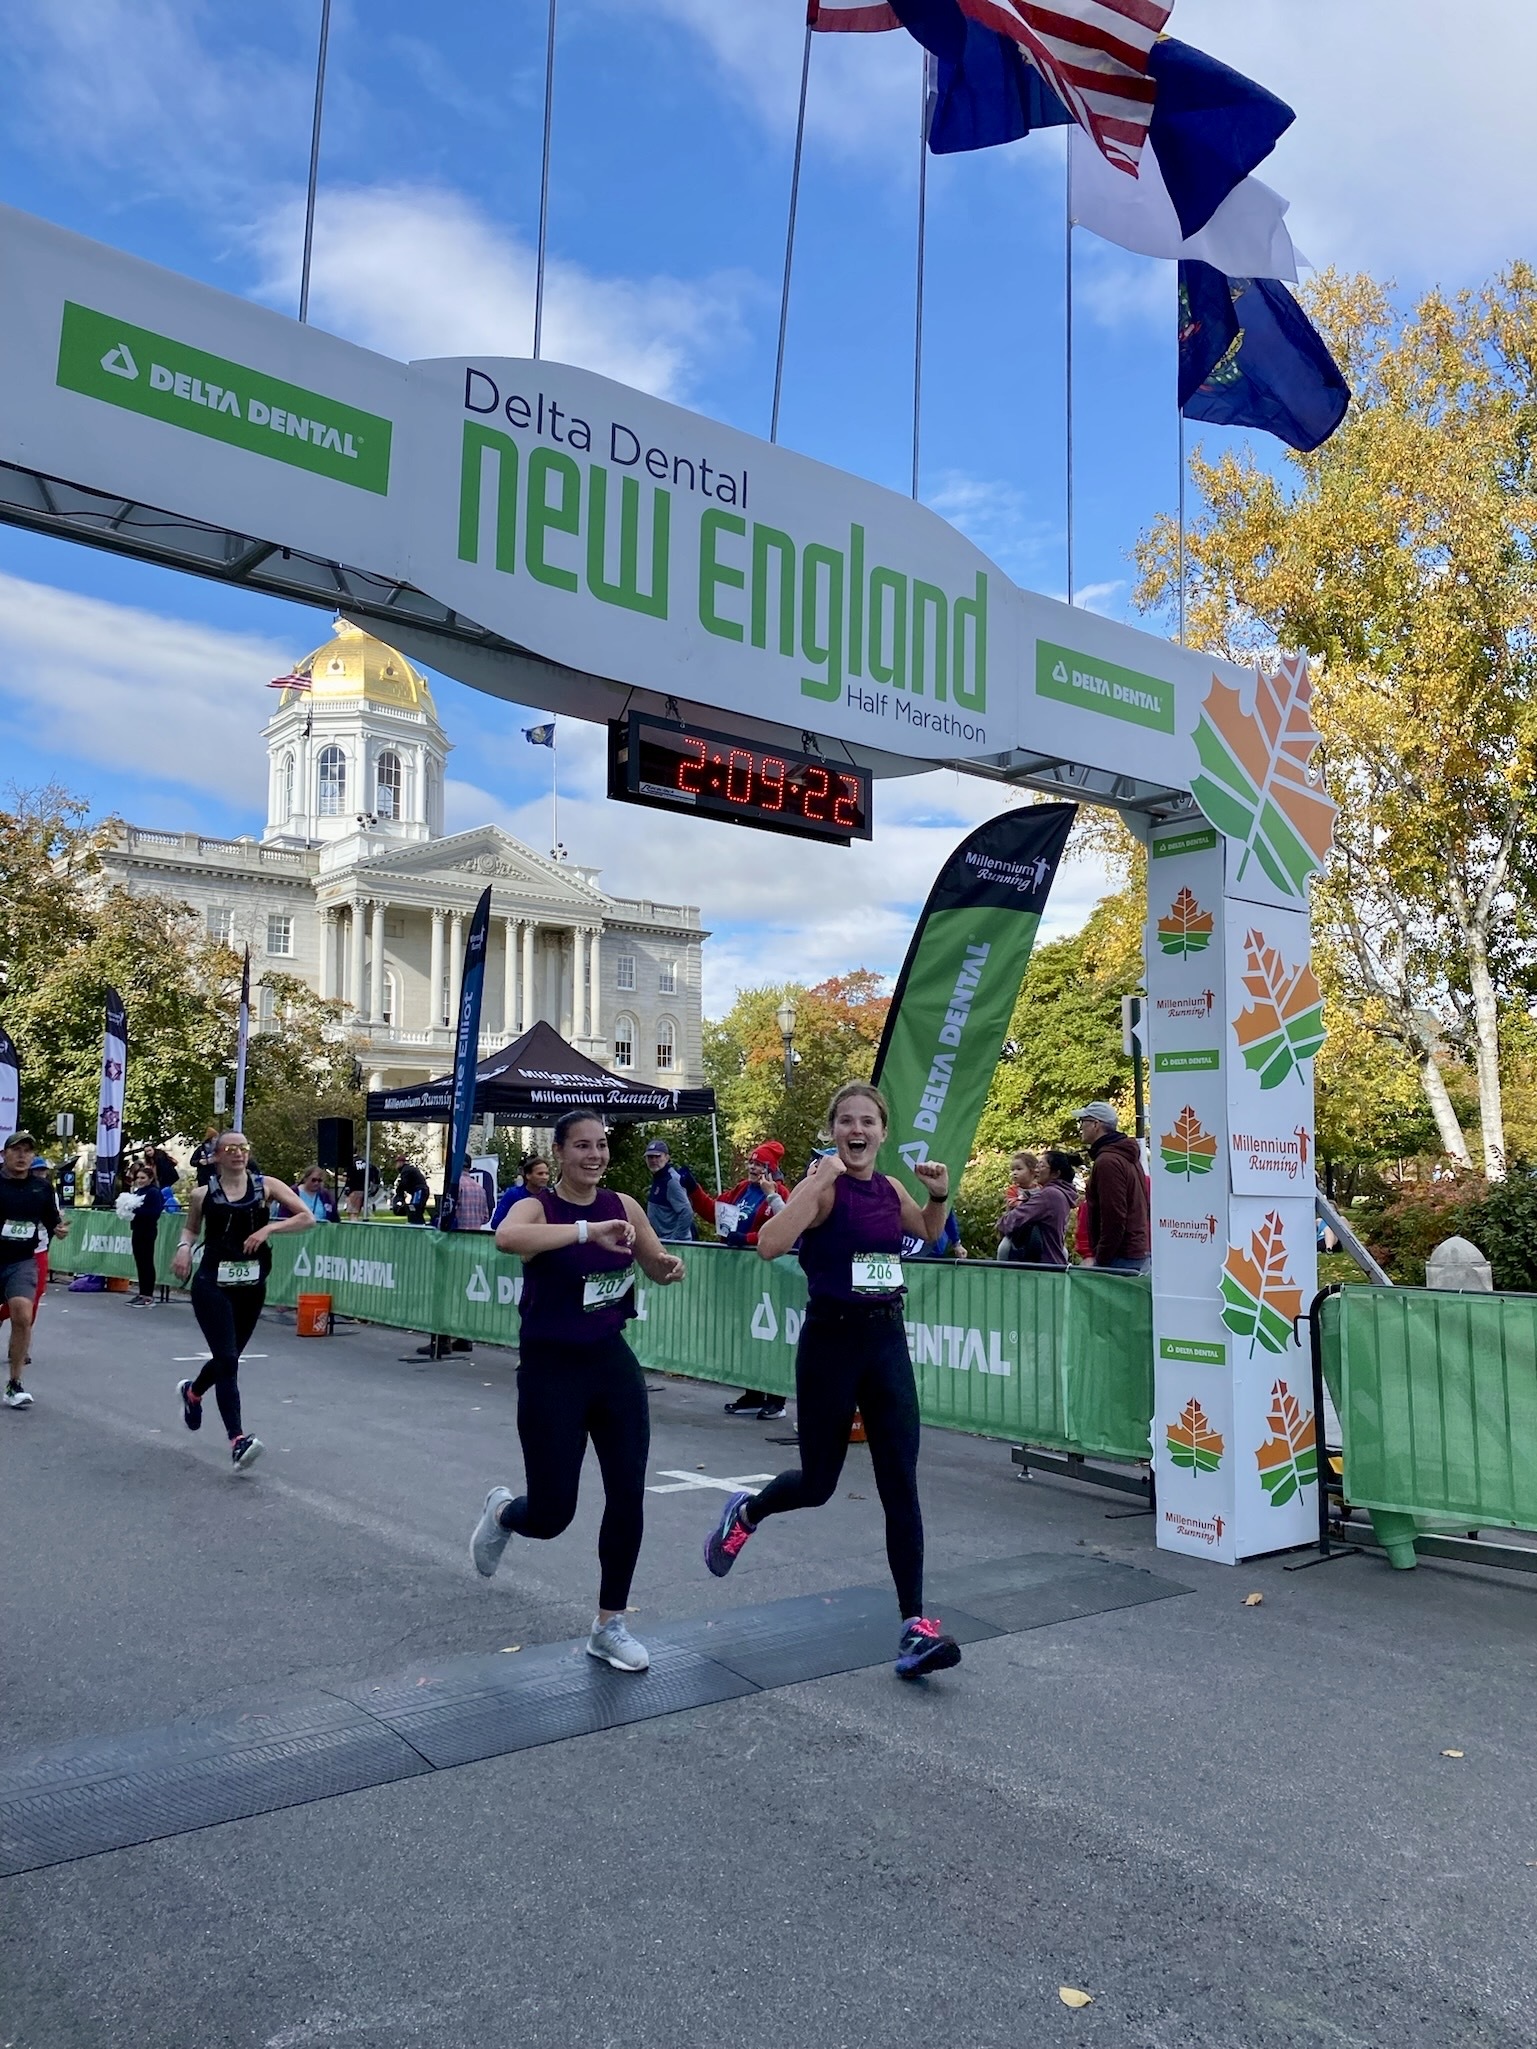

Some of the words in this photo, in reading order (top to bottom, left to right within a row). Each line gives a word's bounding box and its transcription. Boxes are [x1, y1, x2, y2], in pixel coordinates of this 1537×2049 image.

[150, 363, 241, 418] DELTA
[247, 398, 358, 459] DENTAL
[464, 366, 592, 453] Delta
[610, 422, 748, 509] Dental
[698, 507, 988, 715] England
[1072, 669, 1111, 698] DELTA
[1112, 683, 1161, 713] DENTAL
[847, 684, 889, 717] Half
[895, 698, 986, 744] Marathon
[1167, 841, 1186, 850] DELTA
[1186, 835, 1210, 847] DENTAL
[965, 851, 1035, 877] Millennium
[976, 868, 1032, 892] Running
[1156, 996, 1206, 1009] Millennium
[1167, 1006, 1206, 1019] Running
[458, 991, 474, 1058] Elliot
[912, 1053, 957, 1134] DELTA
[938, 941, 992, 1048] DENTAL
[1169, 1057, 1188, 1066] DELTA
[1188, 1056, 1212, 1065] DENTAL
[454, 1063, 465, 1111] The
[384, 1095, 421, 1110] Millennium
[421, 1090, 452, 1111] Runnin
[530, 1090, 605, 1104] Millennium
[606, 1089, 671, 1110] Running
[1232, 1133, 1299, 1154] Millennium
[1249, 1155, 1299, 1180] Running
[1159, 1218, 1209, 1230] Millennium
[1170, 1228, 1209, 1241] Running
[228, 1268, 250, 1278] 503
[314, 1254, 349, 1282] DELTA
[350, 1258, 395, 1289] DENTAL
[867, 1263, 892, 1280] 206
[596, 1279, 626, 1296] 207
[1175, 1345, 1194, 1355] DELTA
[1194, 1347, 1219, 1358] DENTAL
[1165, 1511, 1216, 1532] Millennium
[1176, 1524, 1215, 1545] Running
